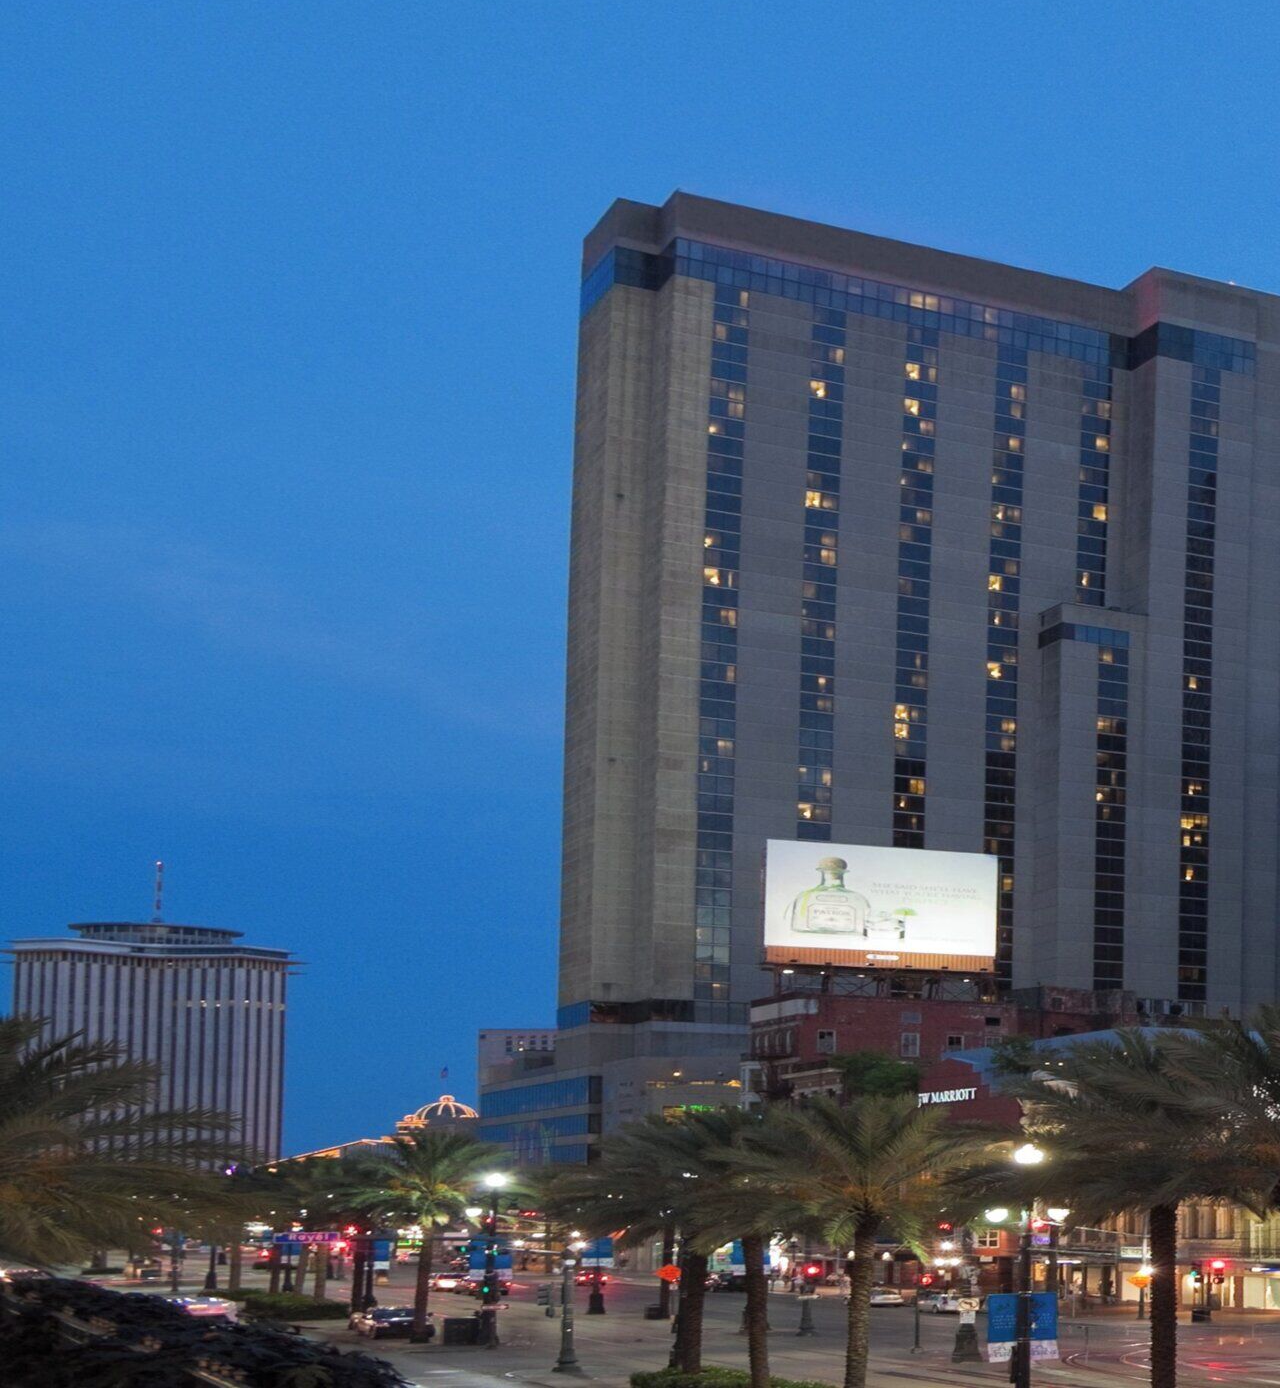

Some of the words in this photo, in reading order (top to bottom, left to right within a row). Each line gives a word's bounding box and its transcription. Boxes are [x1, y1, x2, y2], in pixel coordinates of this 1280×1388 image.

[917, 1092, 930, 1108] JW
[931, 1087, 978, 1104] MARRIOTT
[288, 1232, 330, 1243] Royal
